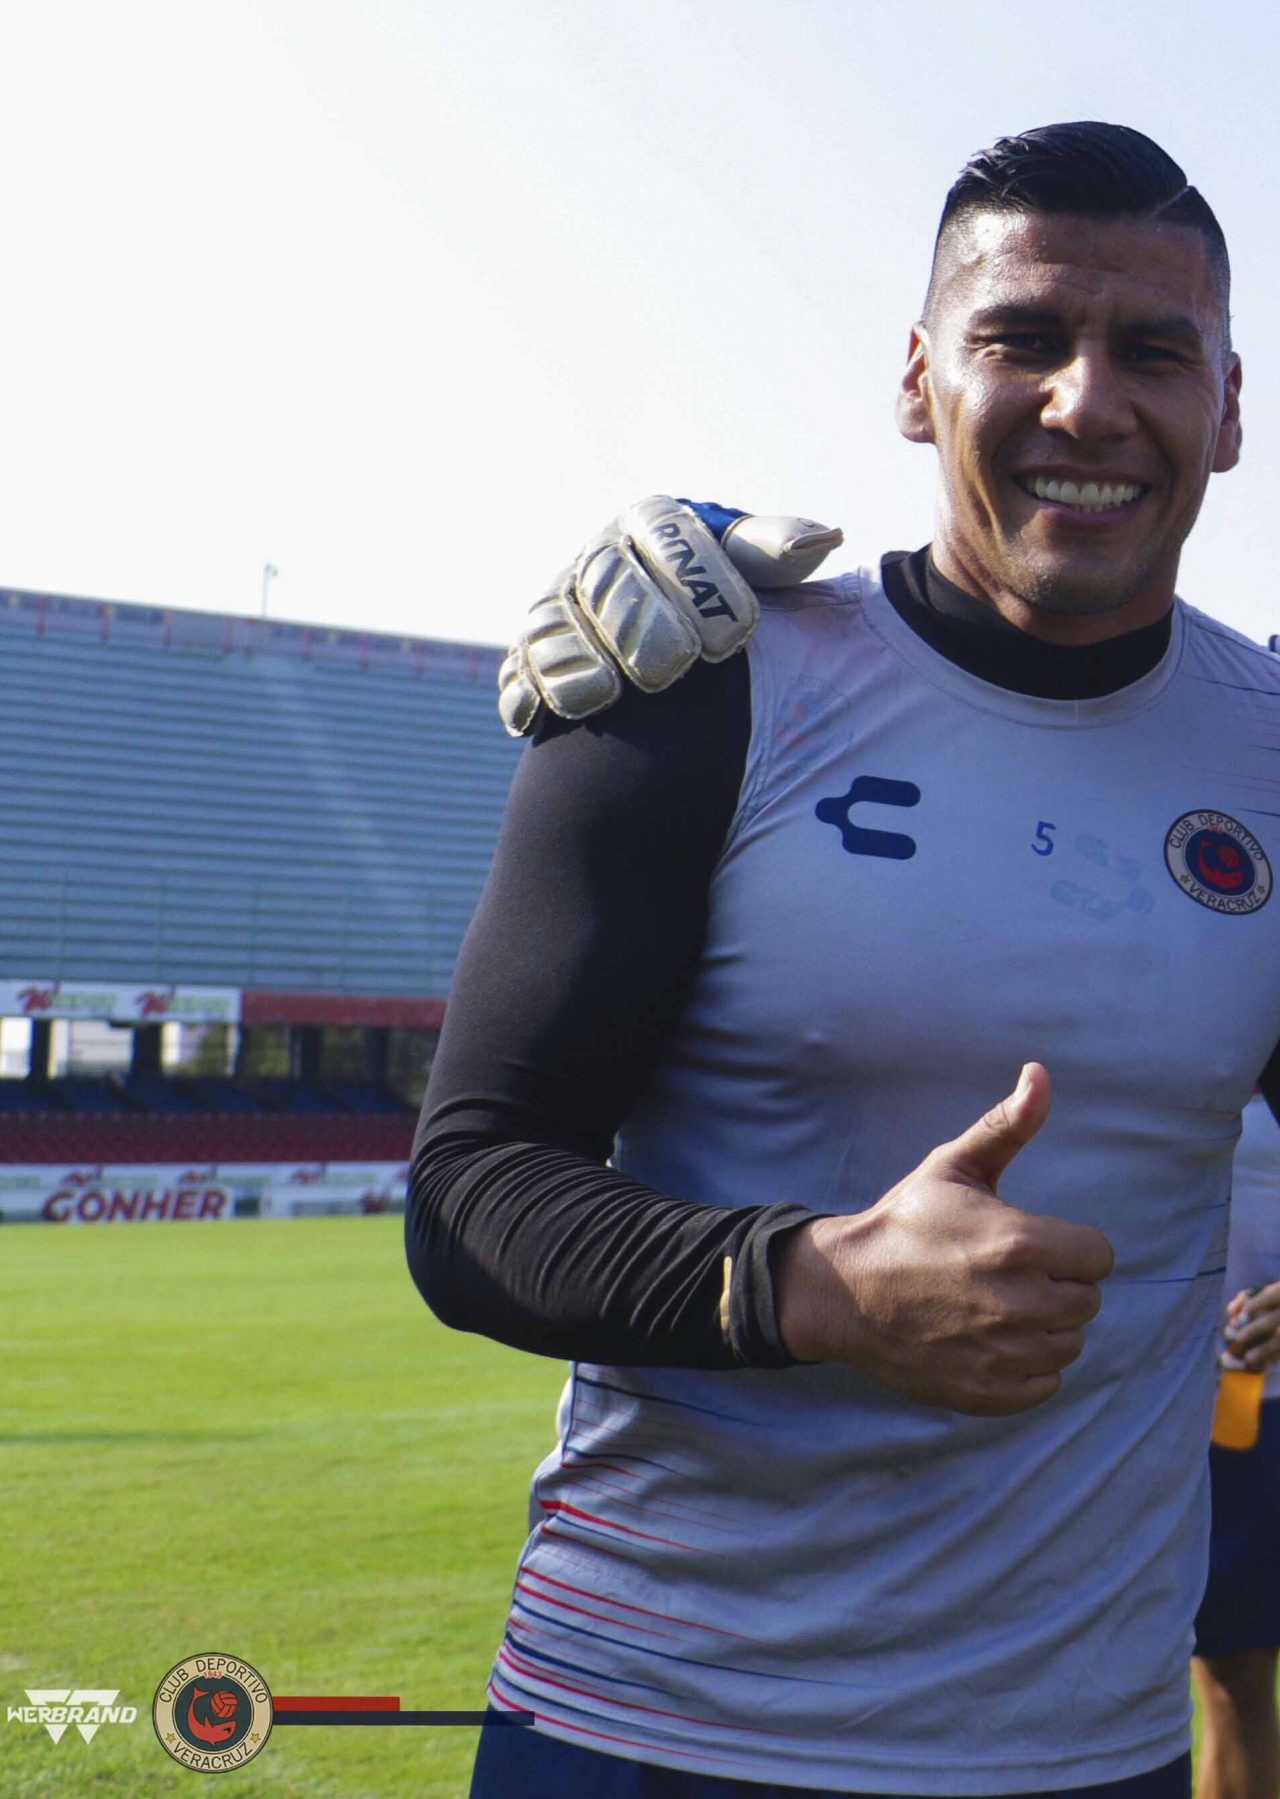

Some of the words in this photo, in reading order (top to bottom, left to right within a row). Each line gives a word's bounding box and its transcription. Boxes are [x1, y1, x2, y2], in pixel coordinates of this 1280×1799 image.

[655, 523, 738, 622] RINAT
[1030, 820, 1057, 857] 5
[1169, 819, 1195, 848] CLUB
[1198, 813, 1264, 861] DEPORTIVO
[1188, 881, 1261, 912] VERACRUZ
[42, 1187, 228, 1223] GONHER
